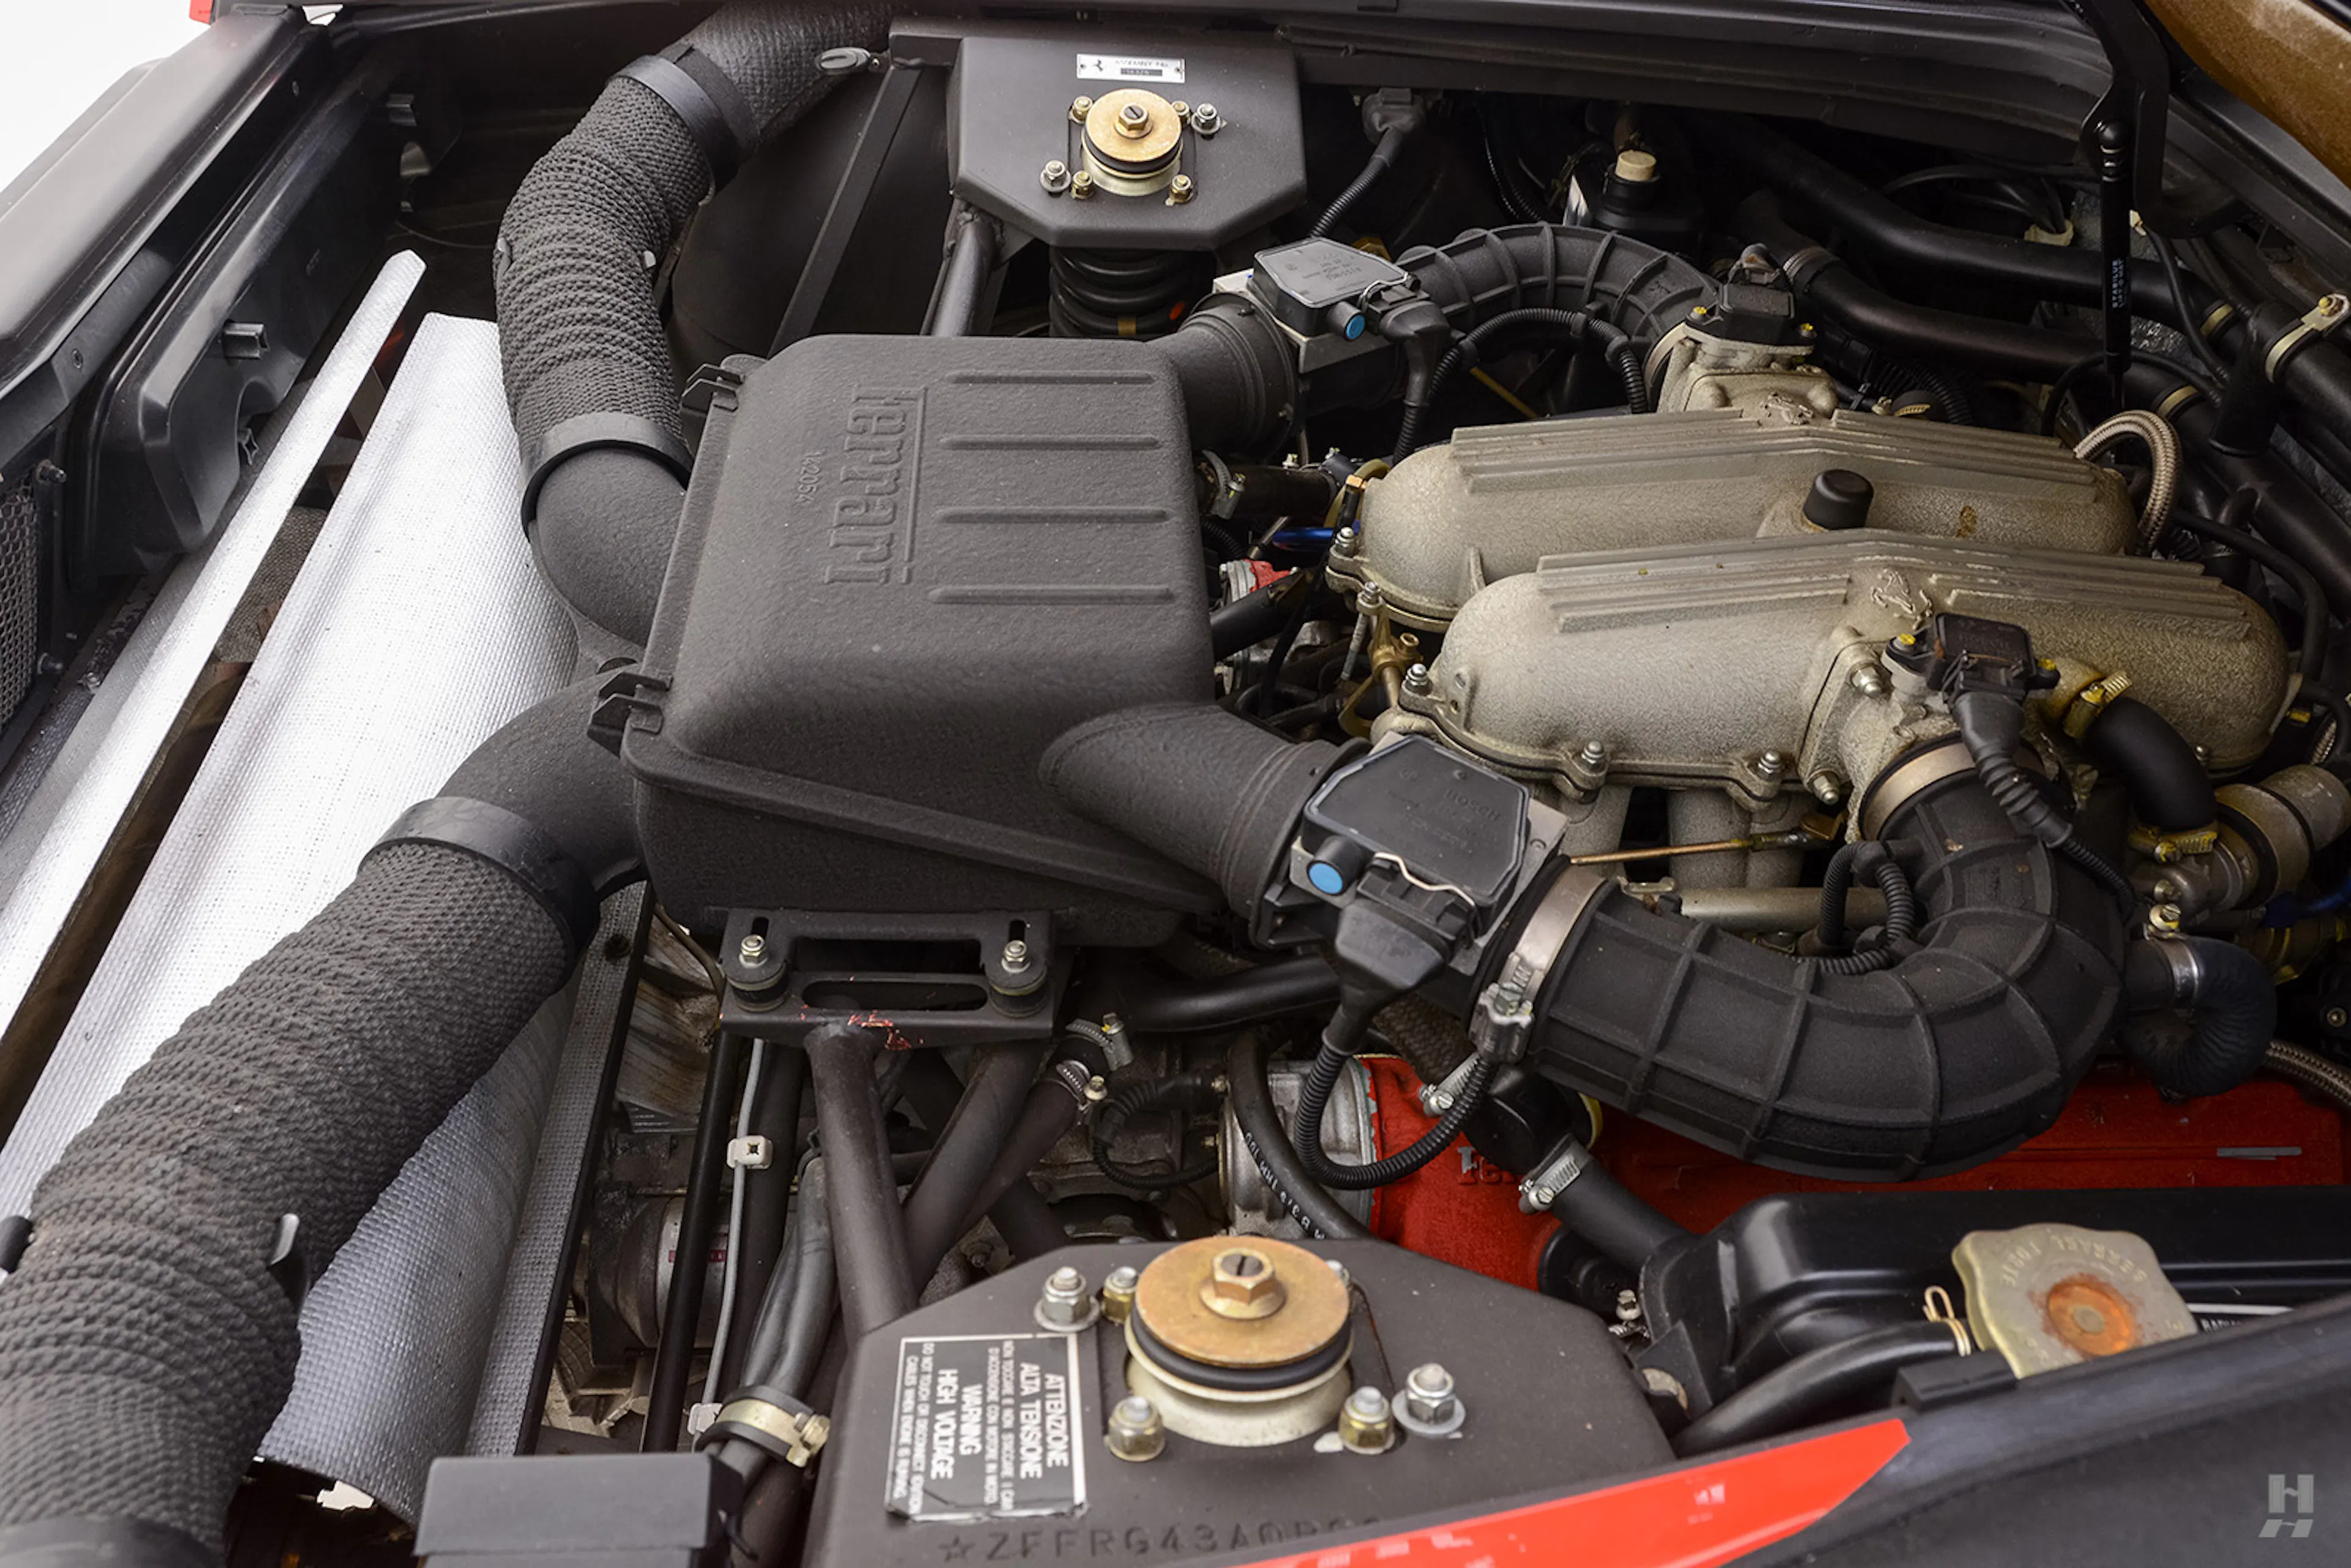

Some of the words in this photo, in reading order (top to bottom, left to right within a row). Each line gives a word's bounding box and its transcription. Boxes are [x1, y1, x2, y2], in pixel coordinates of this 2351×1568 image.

[823, 386, 929, 585] Ferrari
[936, 1369, 959, 1405] HIGH
[1019, 1362, 1041, 1397] ALTA
[930, 1409, 956, 1480] VOLTAGE
[959, 1384, 983, 1456] WARNING
[1019, 1399, 1043, 1479] TENSIONE
[1044, 1373, 1069, 1468] ATTENZIONE
